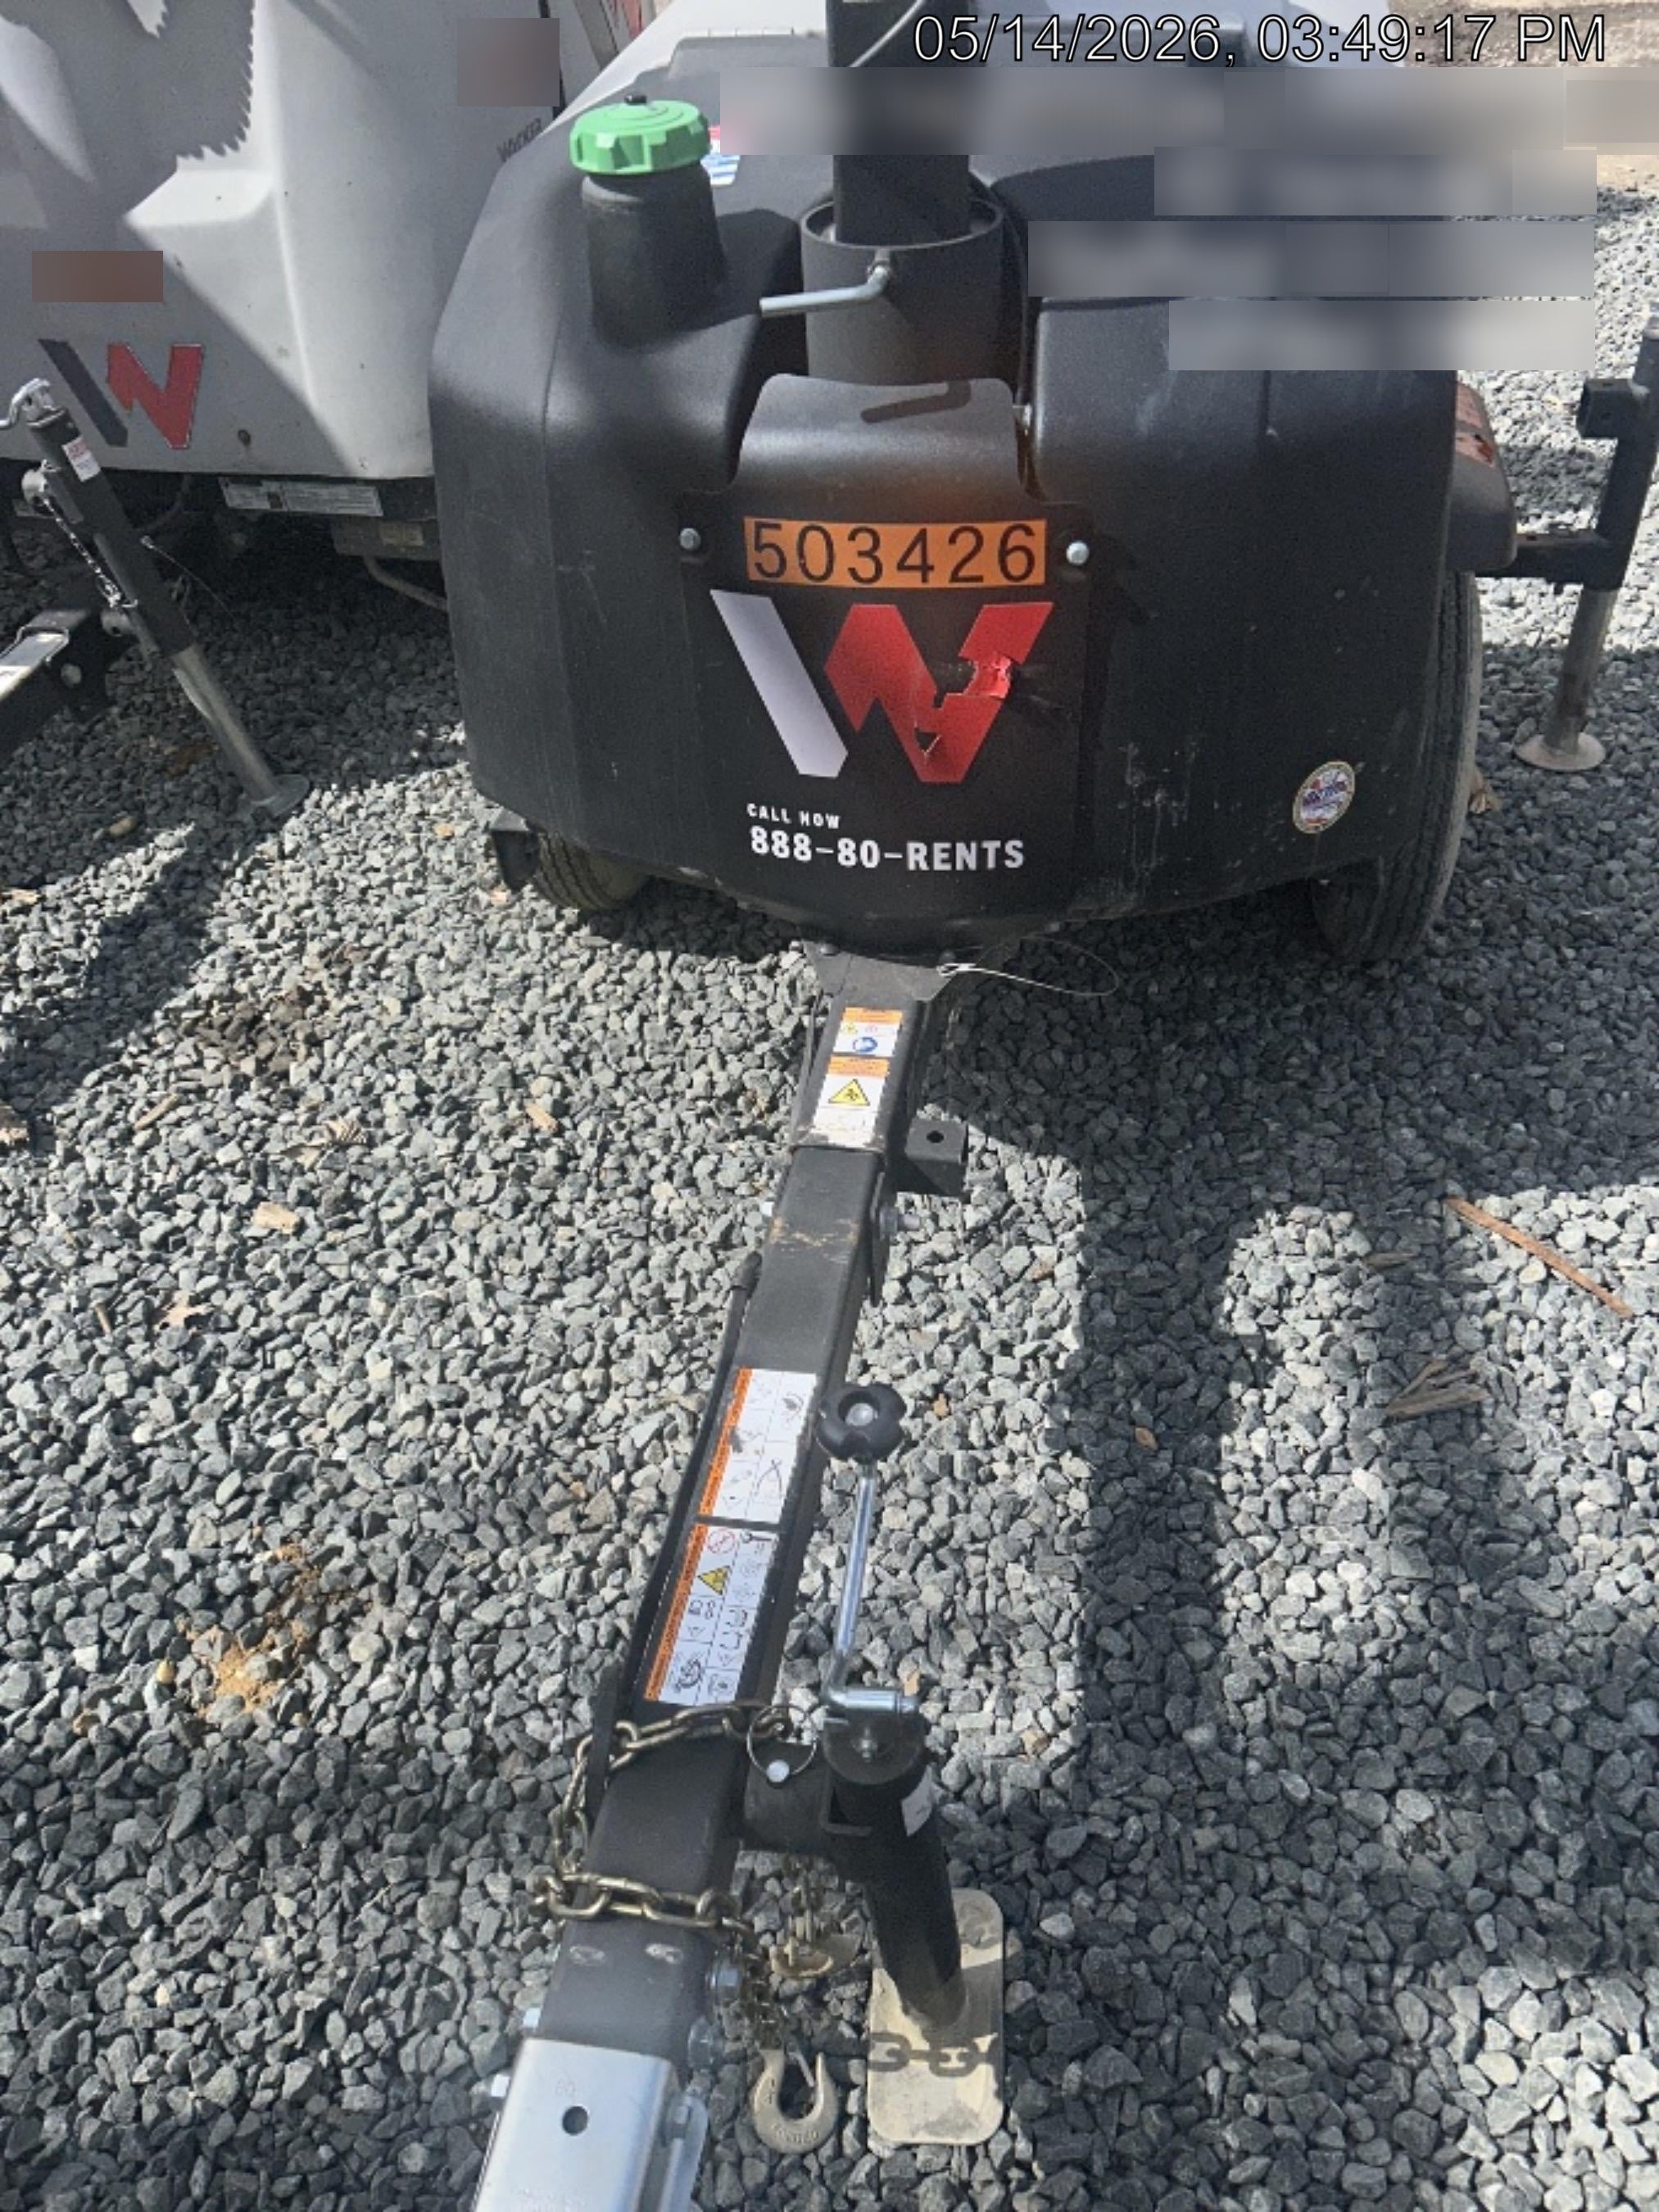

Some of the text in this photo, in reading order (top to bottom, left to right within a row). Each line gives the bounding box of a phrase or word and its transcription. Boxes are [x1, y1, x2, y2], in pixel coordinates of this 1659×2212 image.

[753, 521, 1036, 584] 503426
[709, 589, 1054, 782] W
[746, 803, 841, 829] CALL NOW
[750, 826, 1025, 871] 888-80-RENTS
